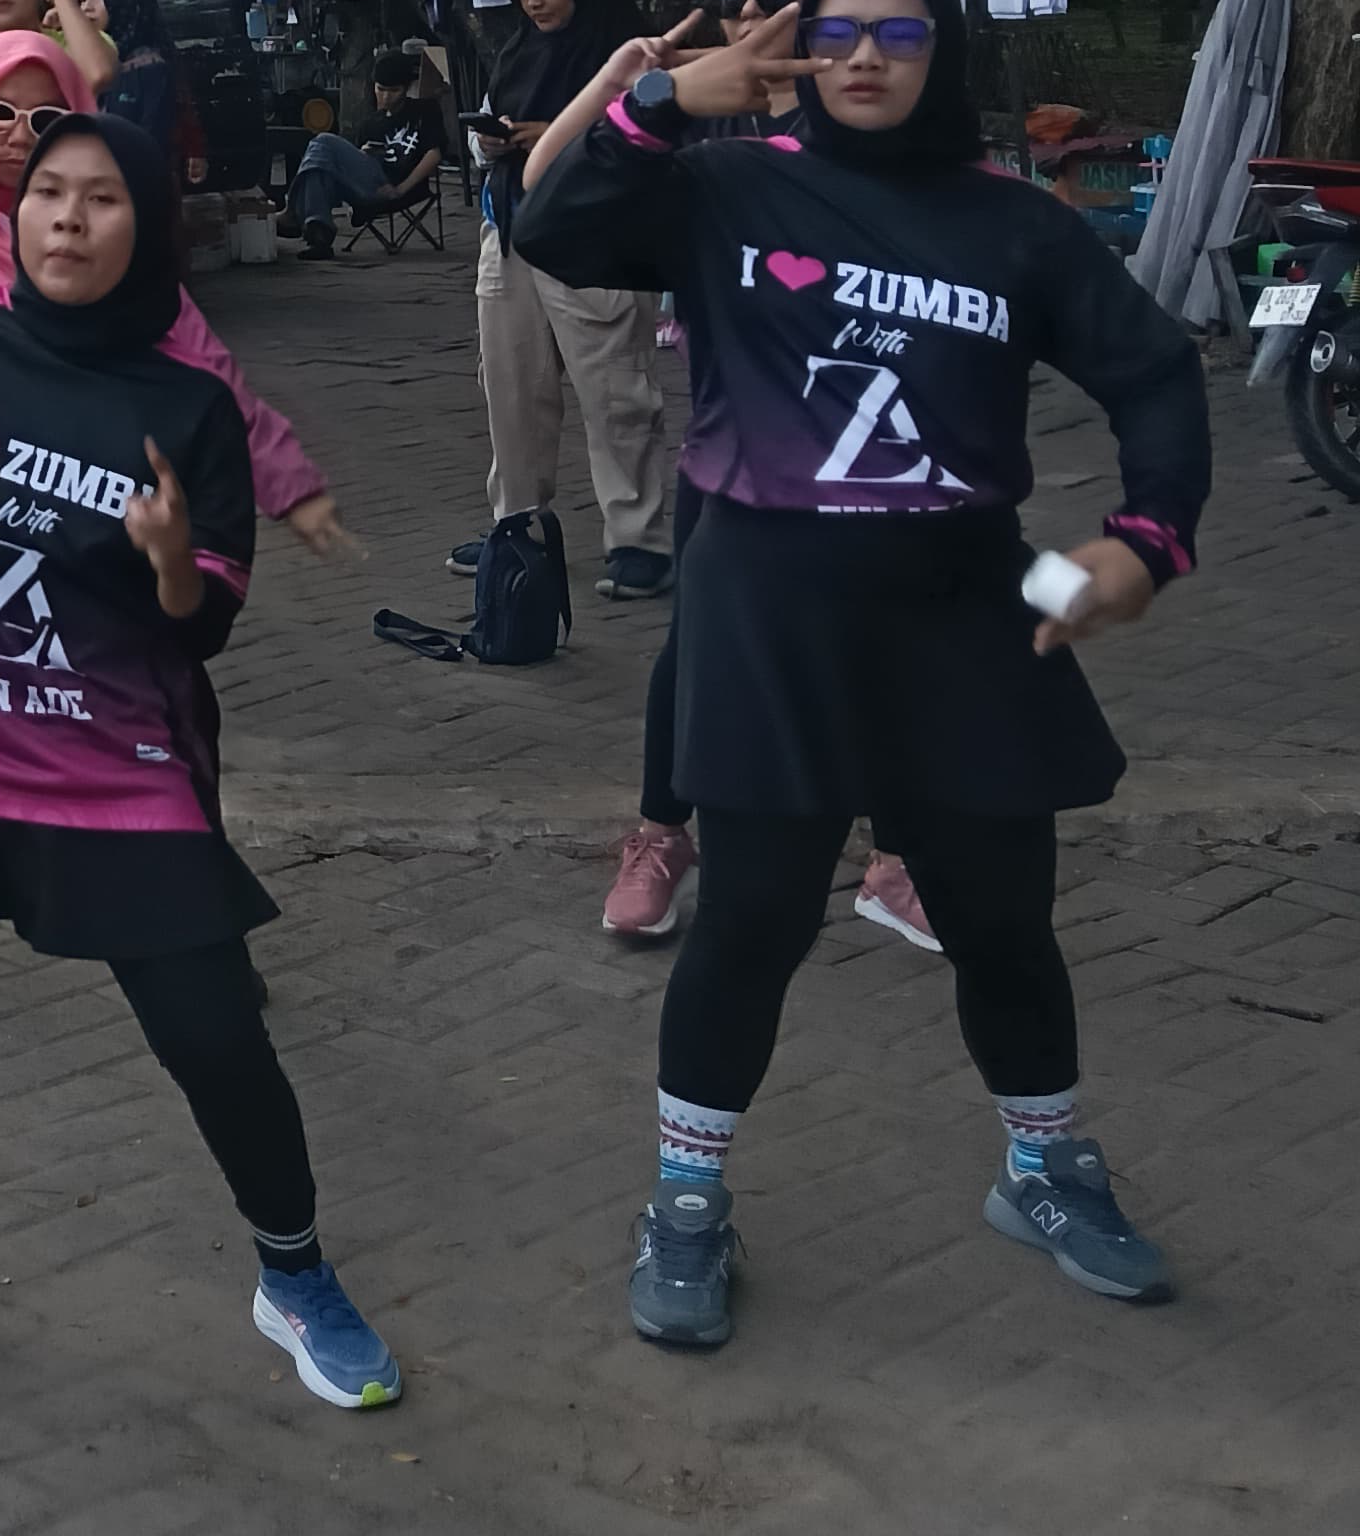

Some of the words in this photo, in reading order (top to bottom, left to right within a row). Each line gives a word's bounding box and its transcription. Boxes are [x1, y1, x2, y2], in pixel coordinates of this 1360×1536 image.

[740, 244, 759, 288] I
[833, 262, 1010, 344] ZUMBA
[832, 318, 914, 358] With
[0, 438, 155, 520] ZUMB
